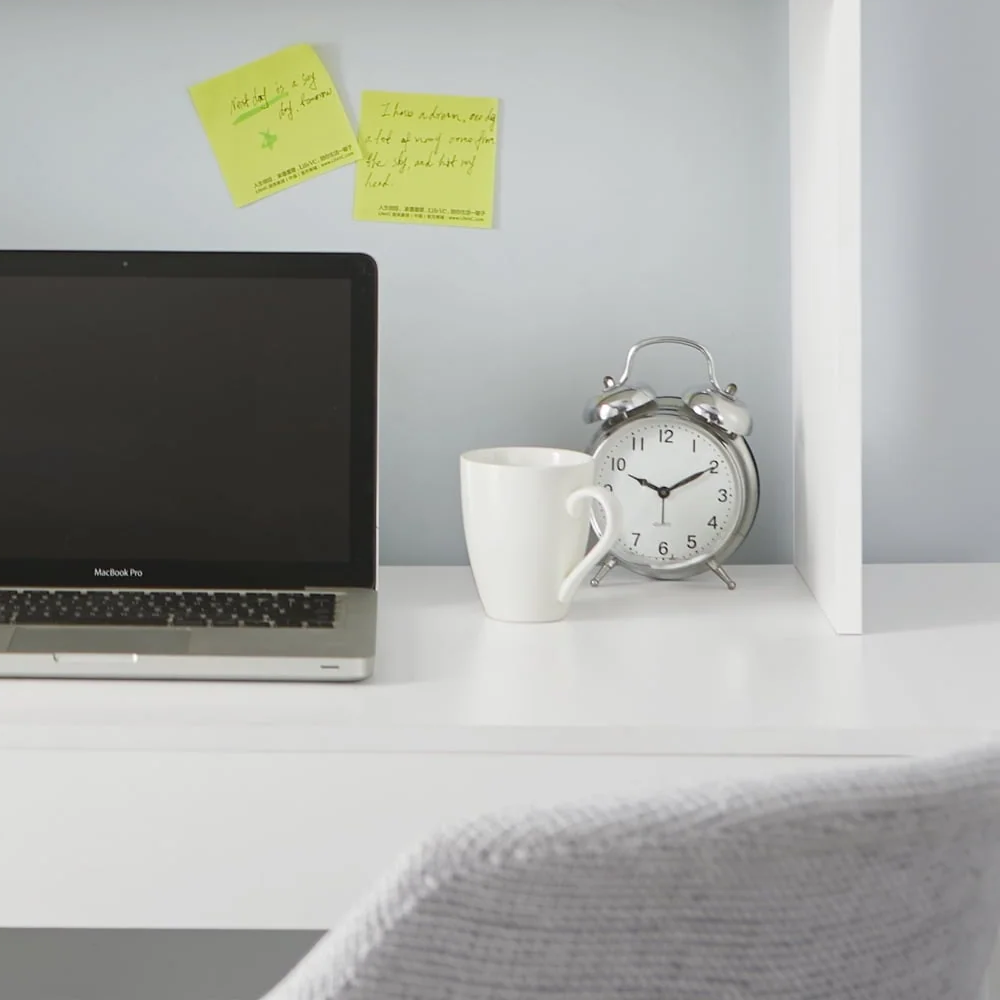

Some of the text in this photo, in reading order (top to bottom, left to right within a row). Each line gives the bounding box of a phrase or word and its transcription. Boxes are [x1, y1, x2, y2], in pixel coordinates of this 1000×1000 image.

[380, 102, 391, 117] I
[659, 429, 674, 443] 12
[632, 437, 644, 451] 11
[692, 439, 696, 453] 1
[611, 457, 626, 472] 10
[709, 460, 719, 474] 2
[718, 488, 728, 502] 3
[707, 516, 718, 529] 4
[632, 533, 641, 547] 7
[687, 535, 697, 549] 5
[658, 541, 668, 556] 6
[94, 568, 143, 577] MacBook Pro
